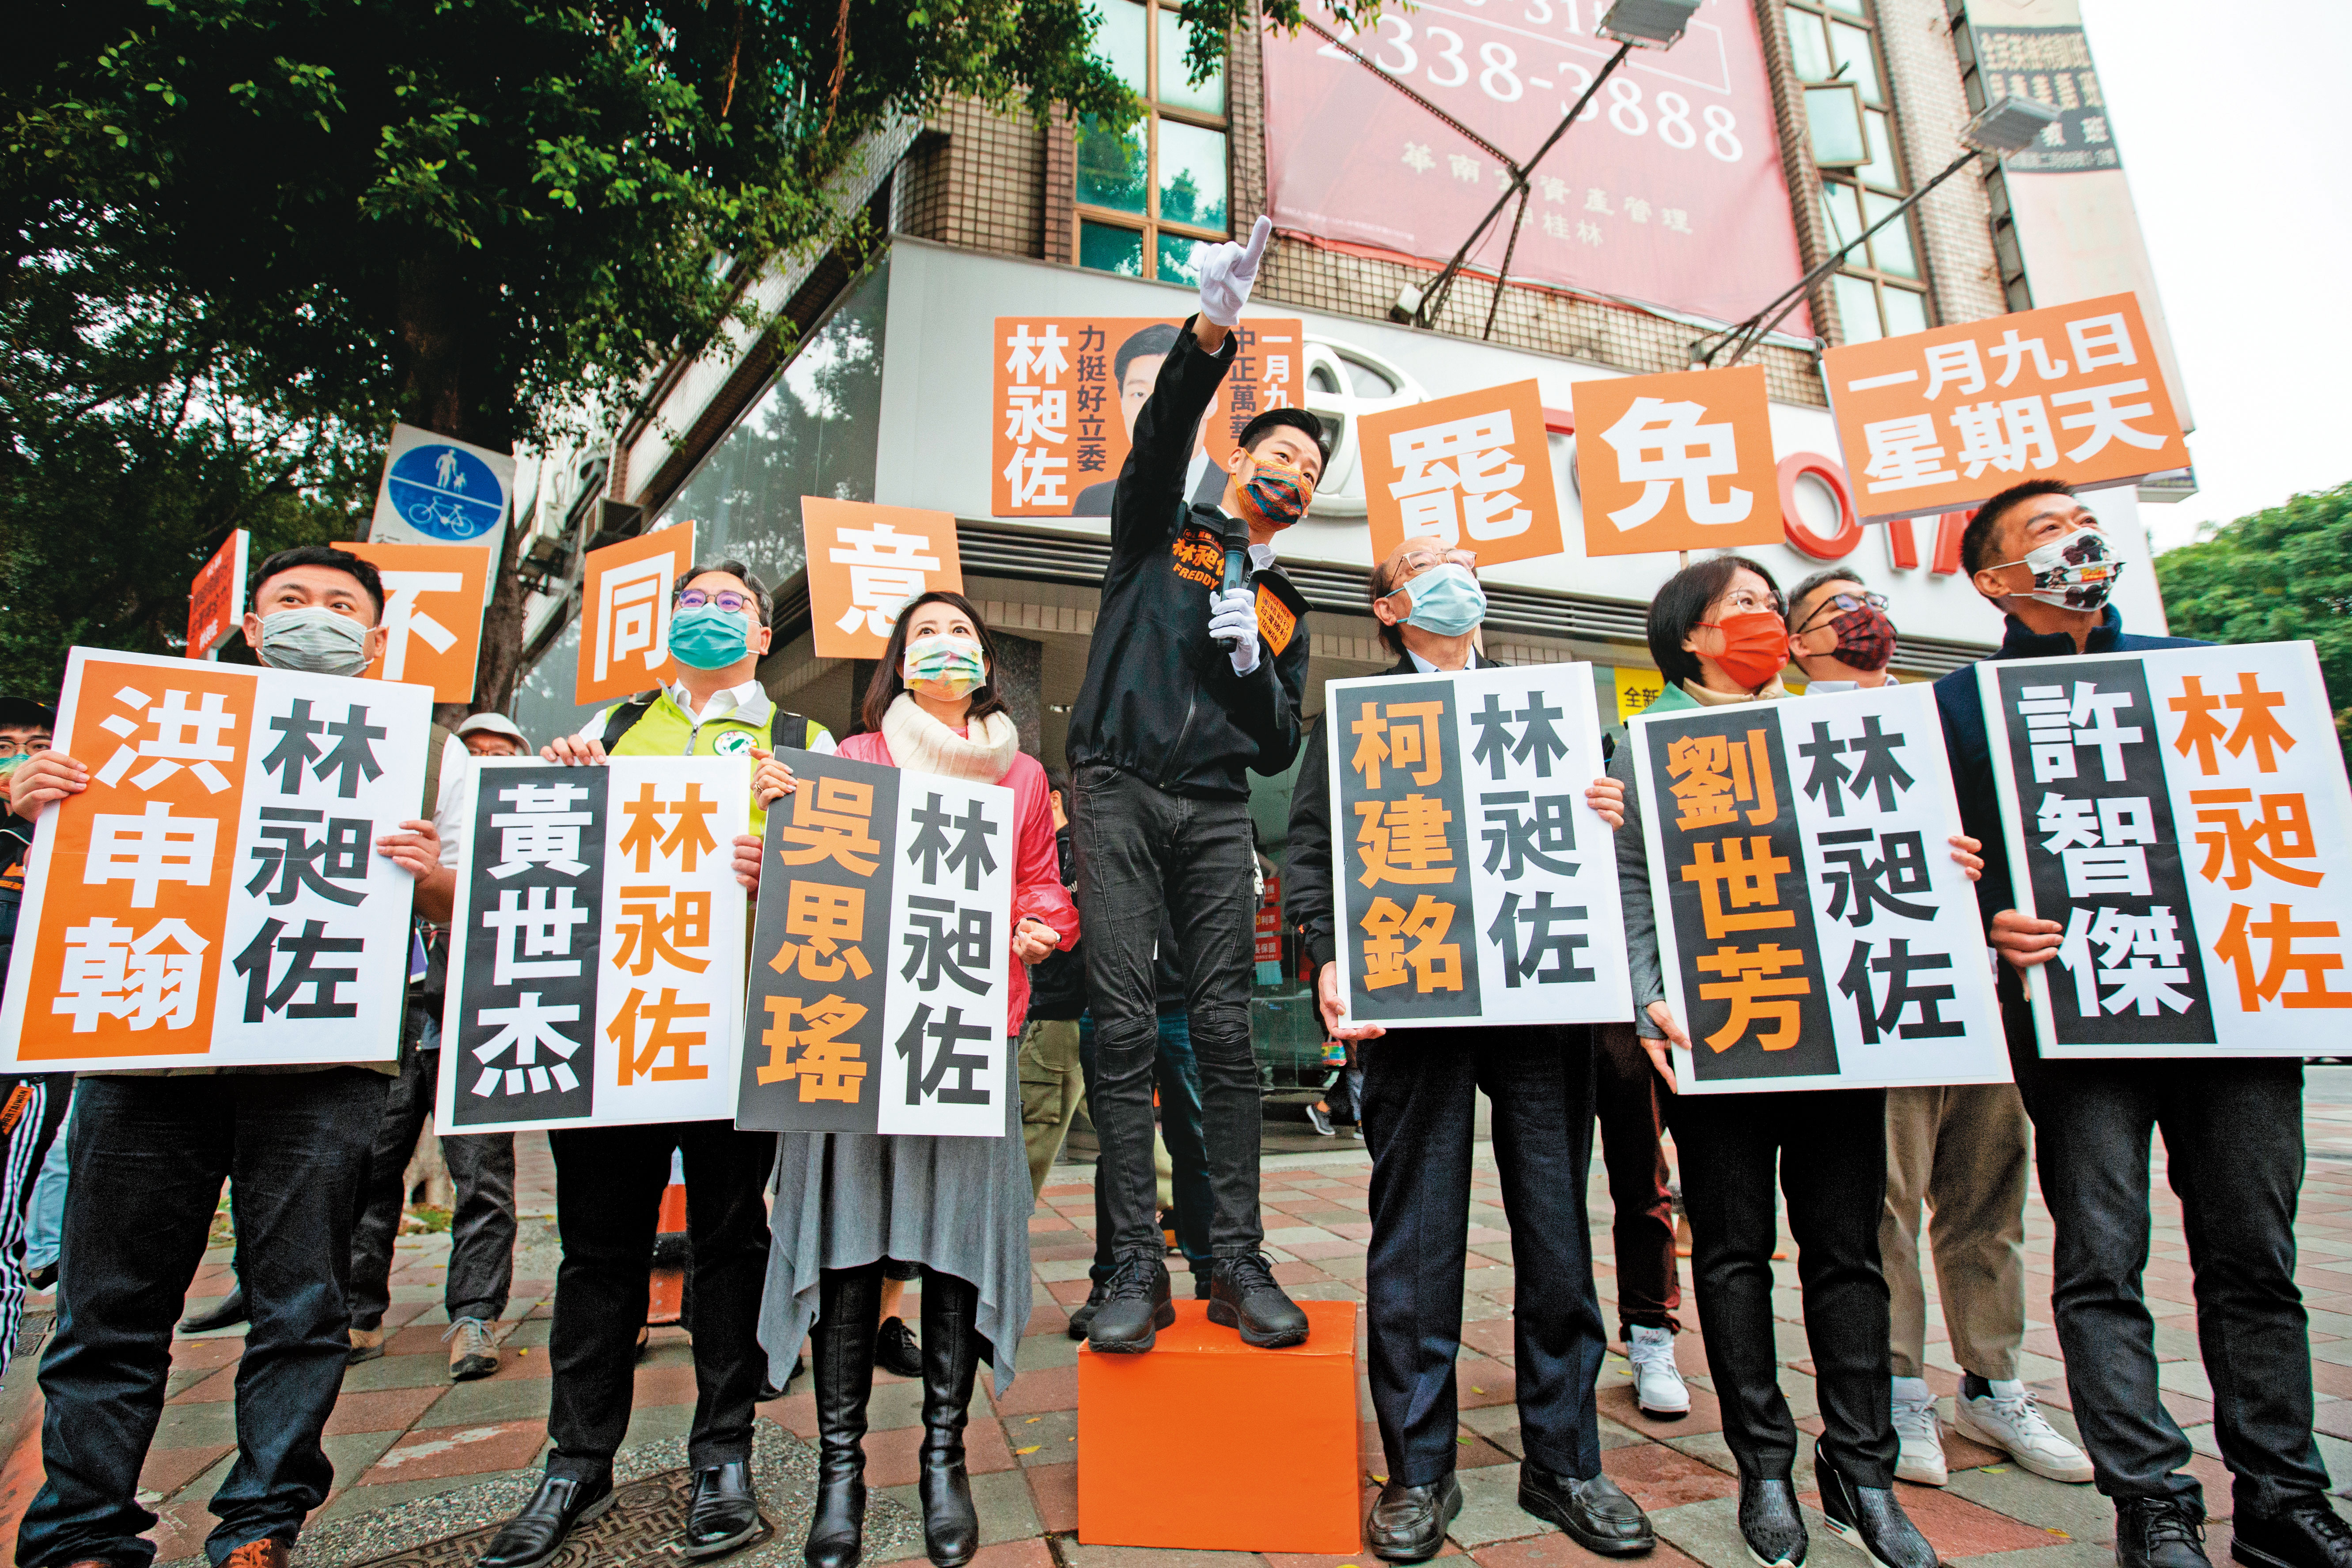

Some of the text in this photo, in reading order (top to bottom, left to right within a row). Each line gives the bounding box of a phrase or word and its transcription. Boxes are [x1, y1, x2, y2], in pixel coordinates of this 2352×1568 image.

[1004, 325, 1069, 508] 林昶佐
[1077, 325, 1106, 472] 力挺好立委
[1848, 312, 2138, 401] 一月九日
[1388, 409, 1533, 548] 罷
[1600, 397, 1754, 532] 免
[1863, 378, 2169, 494] 星期天
[379, 571, 463, 681] 不
[594, 551, 675, 683] 同
[829, 523, 941, 637] 意
[1173, 563, 1219, 590] FREDDY
[1261, 606, 1288, 640] 台灣勝利
[1261, 618, 1278, 643] TAIWAN
[1262, 596, 1290, 630] 團結前行
[1267, 592, 1290, 619] TOGETHER
[1624, 686, 1659, 708] 全新
[52, 686, 236, 1032] 洪申翰
[232, 698, 387, 1023] 林昶佐
[1351, 700, 1463, 994] 柯建銘
[1471, 690, 1596, 988] 林昶佐
[1666, 728, 1810, 1054] 劉世芳
[1799, 715, 1966, 1045] 林昶佐
[2018, 681, 2195, 1017] 許智傑
[2167, 672, 2352, 1012] 林昶佐
[471, 783, 593, 1098] 黃世杰
[606, 782, 719, 1086] 林昶佐
[757, 776, 881, 1103] 吳思瑤
[894, 791, 998, 1106] 林昶佐
